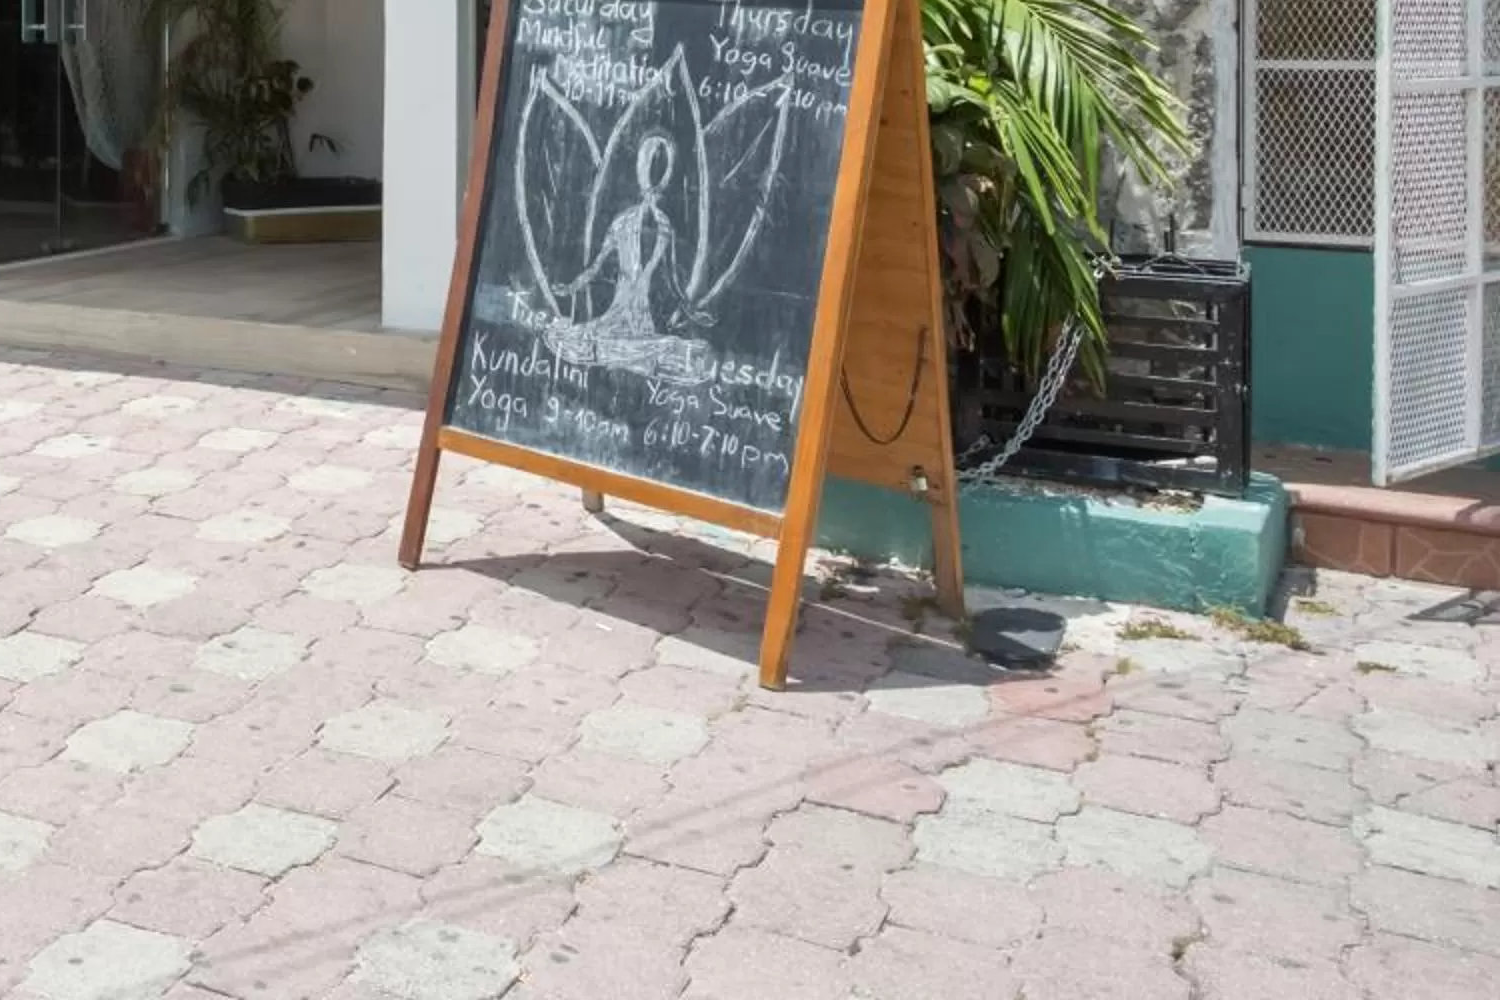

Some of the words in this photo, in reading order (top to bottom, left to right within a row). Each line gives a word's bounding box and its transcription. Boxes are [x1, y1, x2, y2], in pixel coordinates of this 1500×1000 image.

[709, 33, 772, 75] Yoga
[471, 330, 589, 390] Kundalini
[467, 374, 528, 432] Yoga
[646, 378, 700, 415] Yoga
[709, 384, 783, 432] Suave
